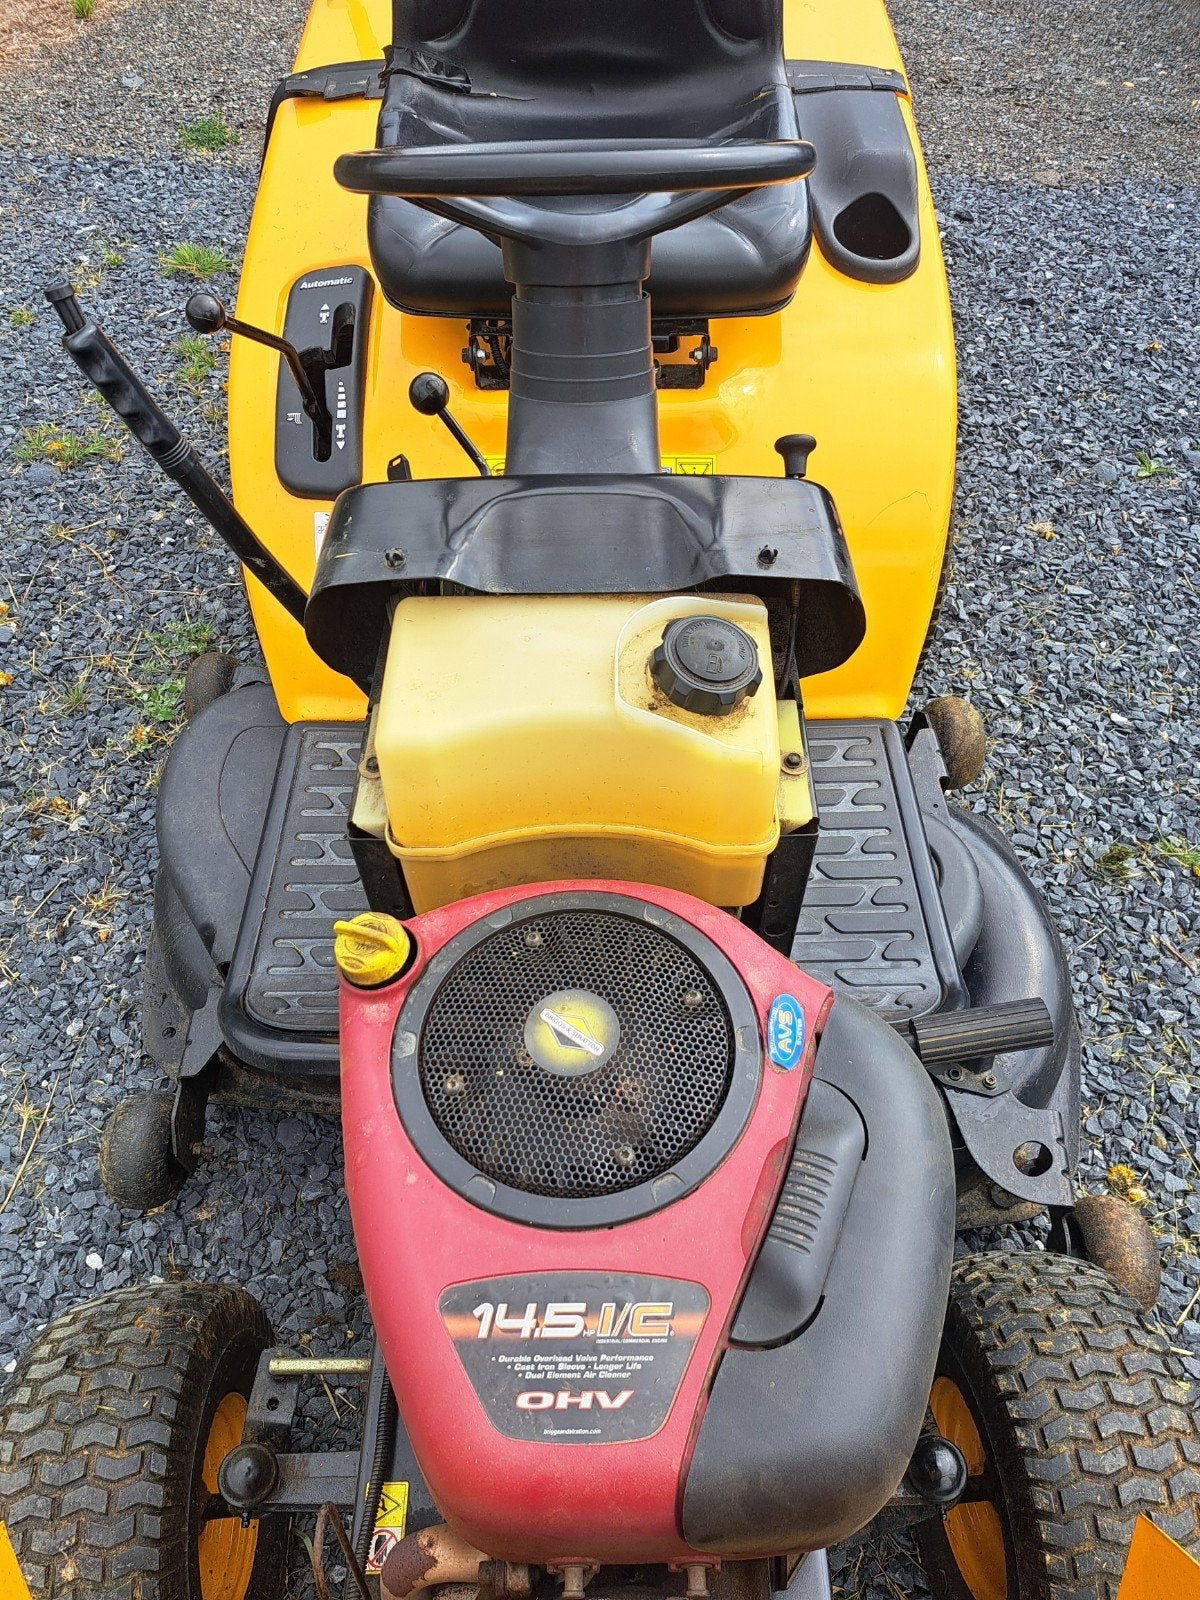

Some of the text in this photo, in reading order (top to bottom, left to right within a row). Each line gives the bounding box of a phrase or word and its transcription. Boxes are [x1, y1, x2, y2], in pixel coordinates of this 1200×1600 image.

[300, 276, 353, 288] Automatic
[778, 1009, 793, 1054] AVS
[571, 1031, 600, 1052] STRATTON
[472, 1302, 587, 1338] 14.5
[600, 1354, 654, 1362] Performance
[594, 1362, 623, 1371] Longer
[626, 1362, 642, 1370] Life
[525, 1371, 631, 1379] Dual Element Air Cleaner
[516, 1390, 634, 1410] OHV
